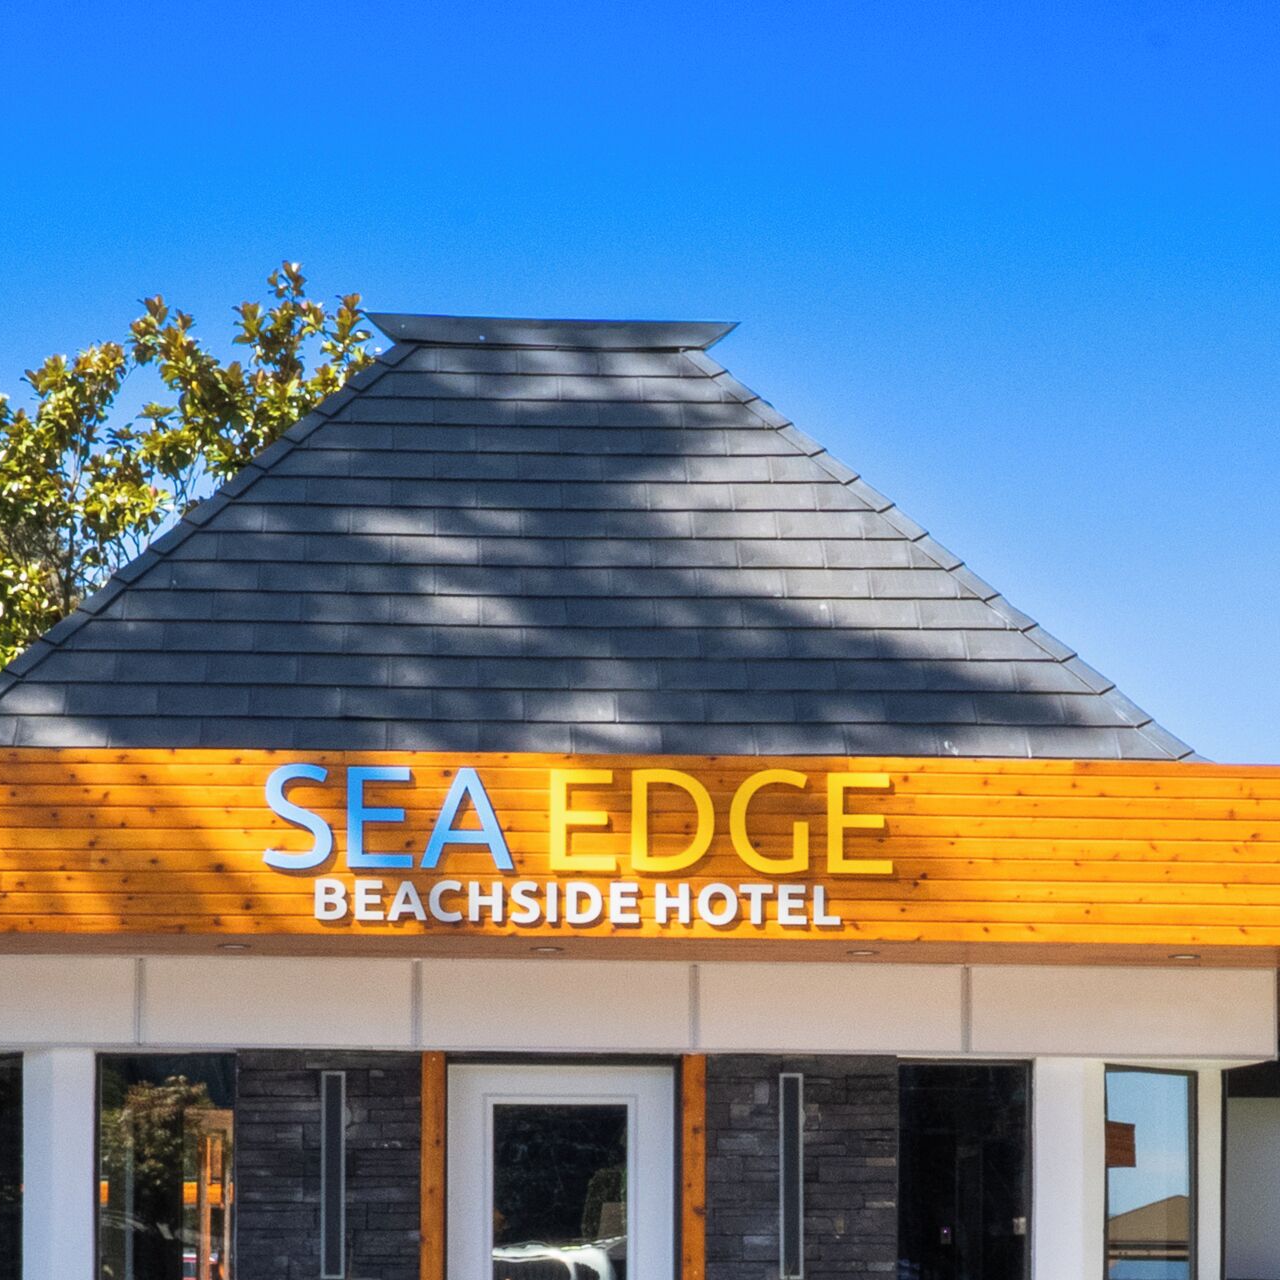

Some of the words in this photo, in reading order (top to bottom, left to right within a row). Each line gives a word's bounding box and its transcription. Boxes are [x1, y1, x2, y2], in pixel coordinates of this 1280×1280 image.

[264, 764, 514, 869] SEA
[549, 768, 893, 874] EDGE
[314, 880, 639, 925] BEACHSIDE
[655, 884, 841, 926] HOTEL
